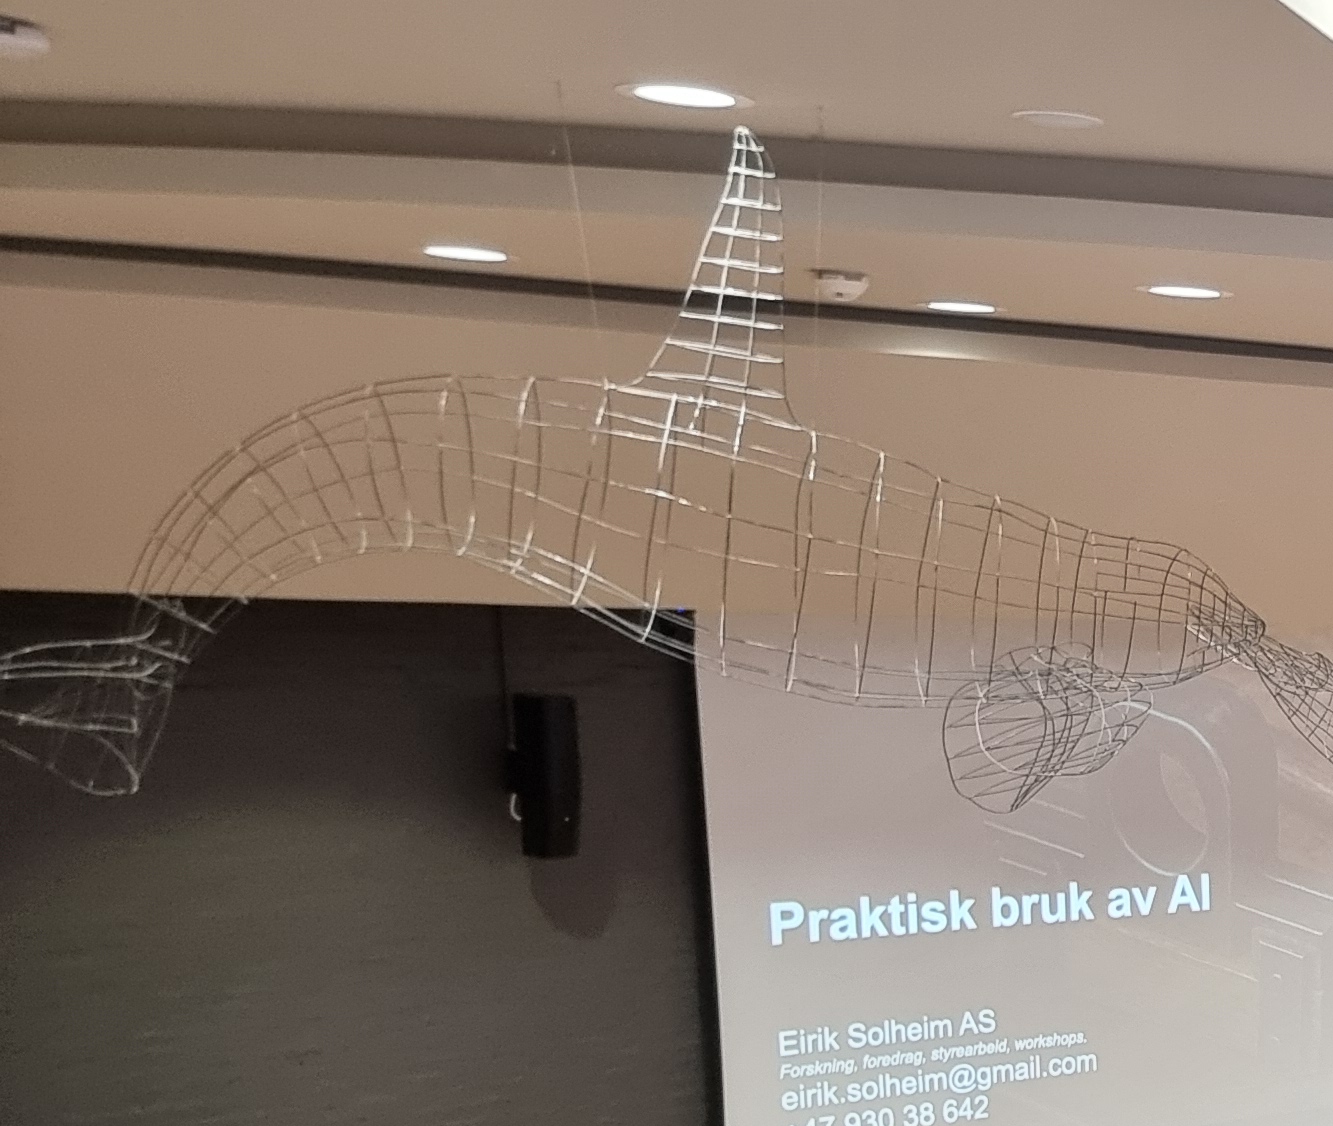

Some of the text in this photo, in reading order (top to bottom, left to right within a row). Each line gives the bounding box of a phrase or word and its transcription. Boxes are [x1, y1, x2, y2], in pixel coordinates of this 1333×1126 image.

[769, 873, 1211, 947] Praktisk bruk av AI
[778, 1009, 996, 1057] Eirik Solheim AS
[779, 1031, 1088, 1080] Forskning, foredrag, styrearbeid, workshops.
[781, 1053, 1098, 1111] eirik.solheim@gmail.com
[942, 1095, 989, 1123] 642
